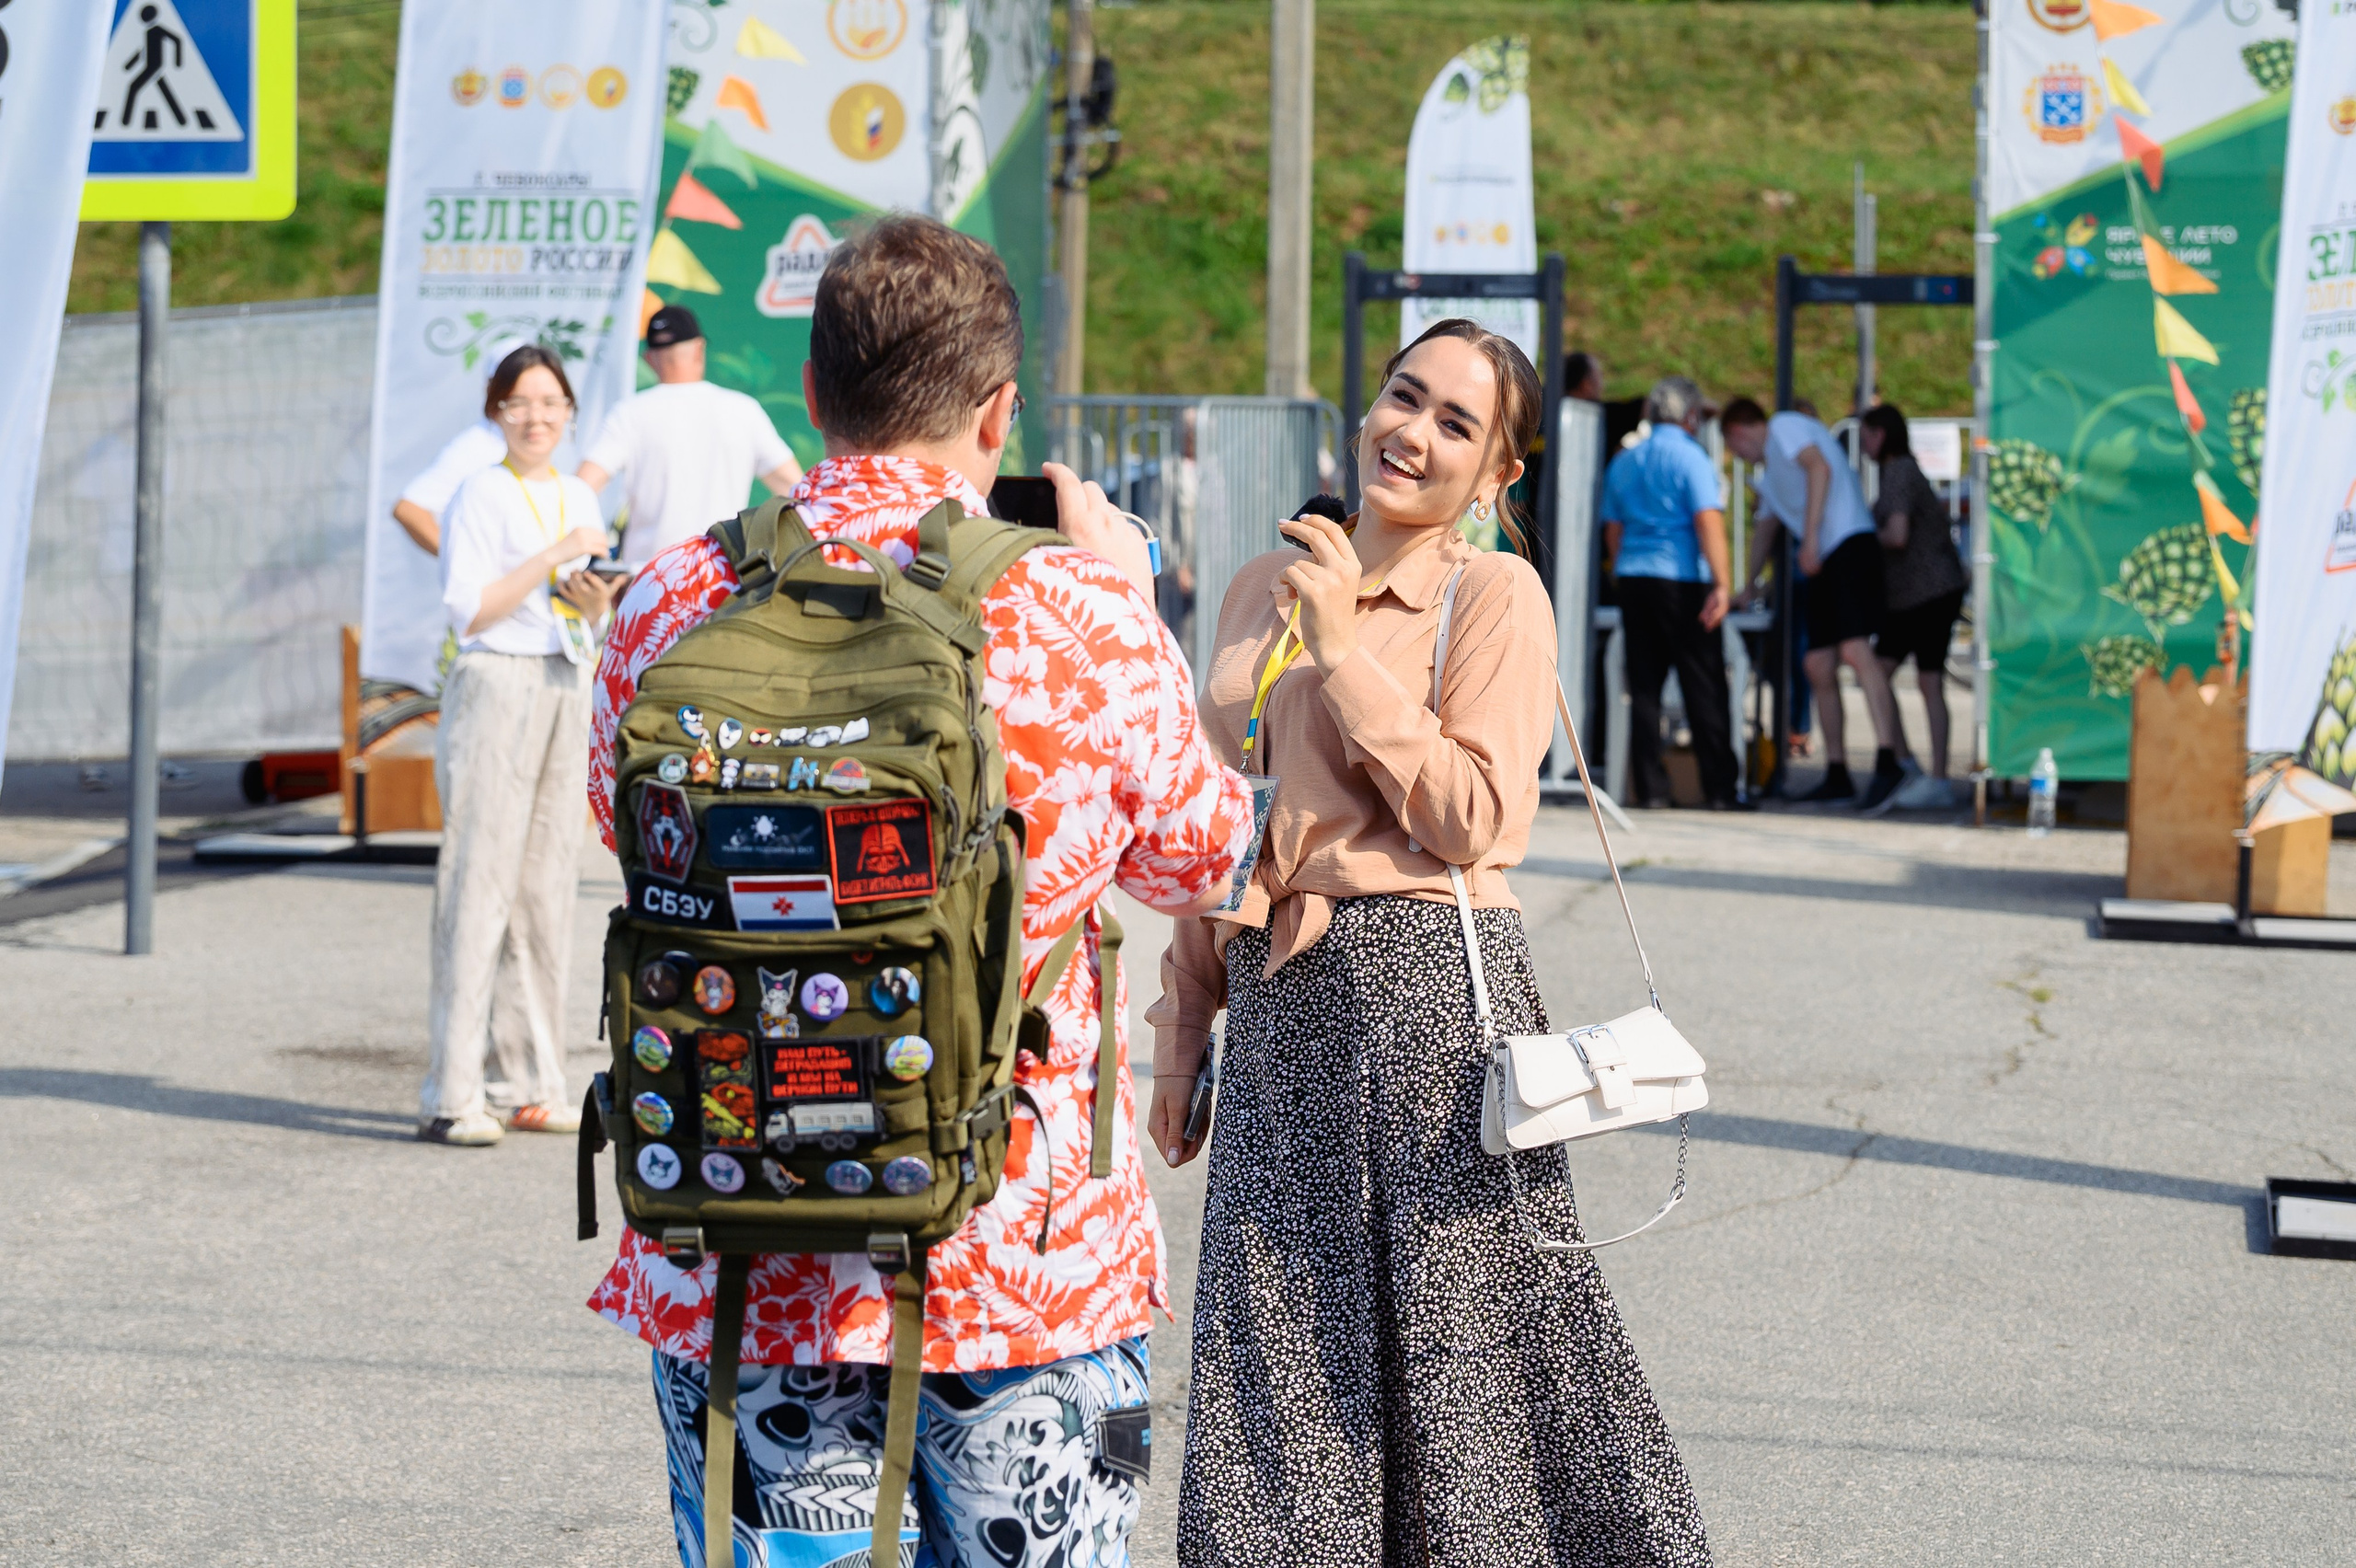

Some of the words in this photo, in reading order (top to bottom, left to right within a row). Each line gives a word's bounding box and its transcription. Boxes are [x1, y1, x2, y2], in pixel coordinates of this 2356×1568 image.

[421, 197, 640, 243] ЗЕЛЕНОЕ
[2105, 225, 2176, 245] ЯРЕ
[2179, 225, 2238, 245] ЛЕТО
[421, 246, 523, 272] ЗОЛОТО
[531, 247, 633, 271] РОССИИ
